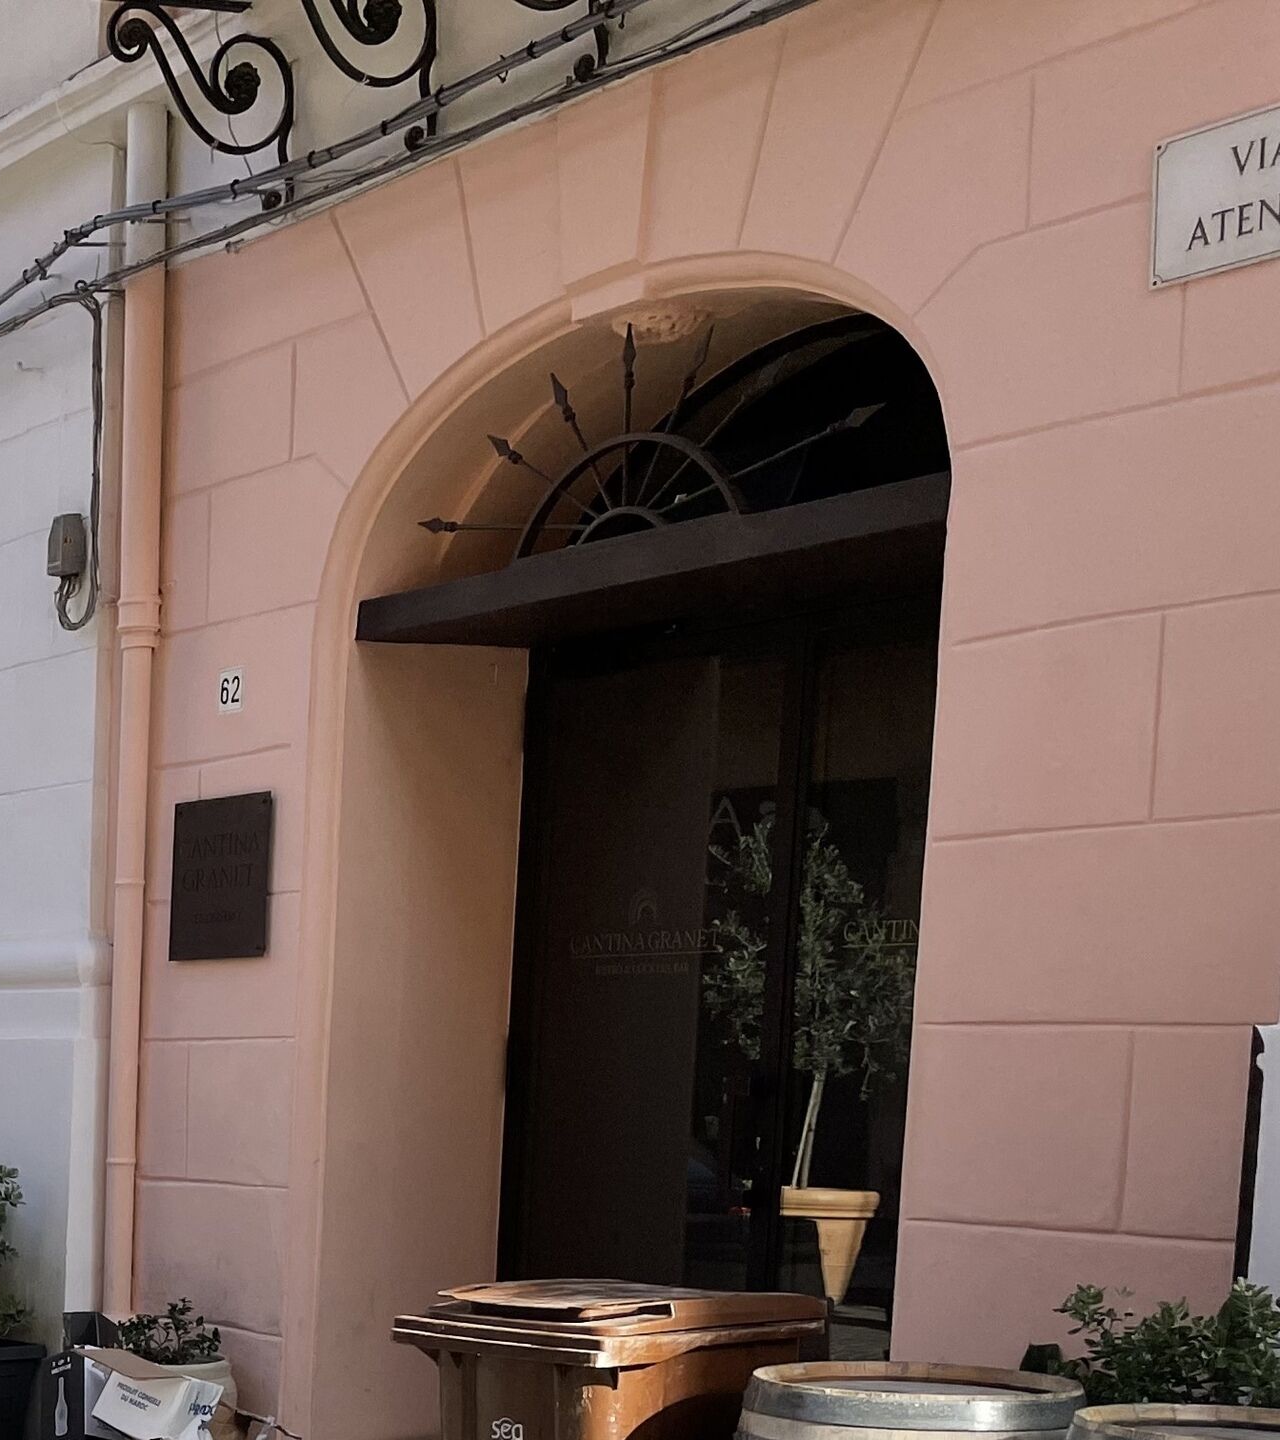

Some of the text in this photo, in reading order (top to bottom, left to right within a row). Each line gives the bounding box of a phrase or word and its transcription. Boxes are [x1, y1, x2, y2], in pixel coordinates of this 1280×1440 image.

[1186, 193, 1280, 252] ATEN
[220, 675, 240, 705] 62
[570, 932, 645, 954] CANTINA
